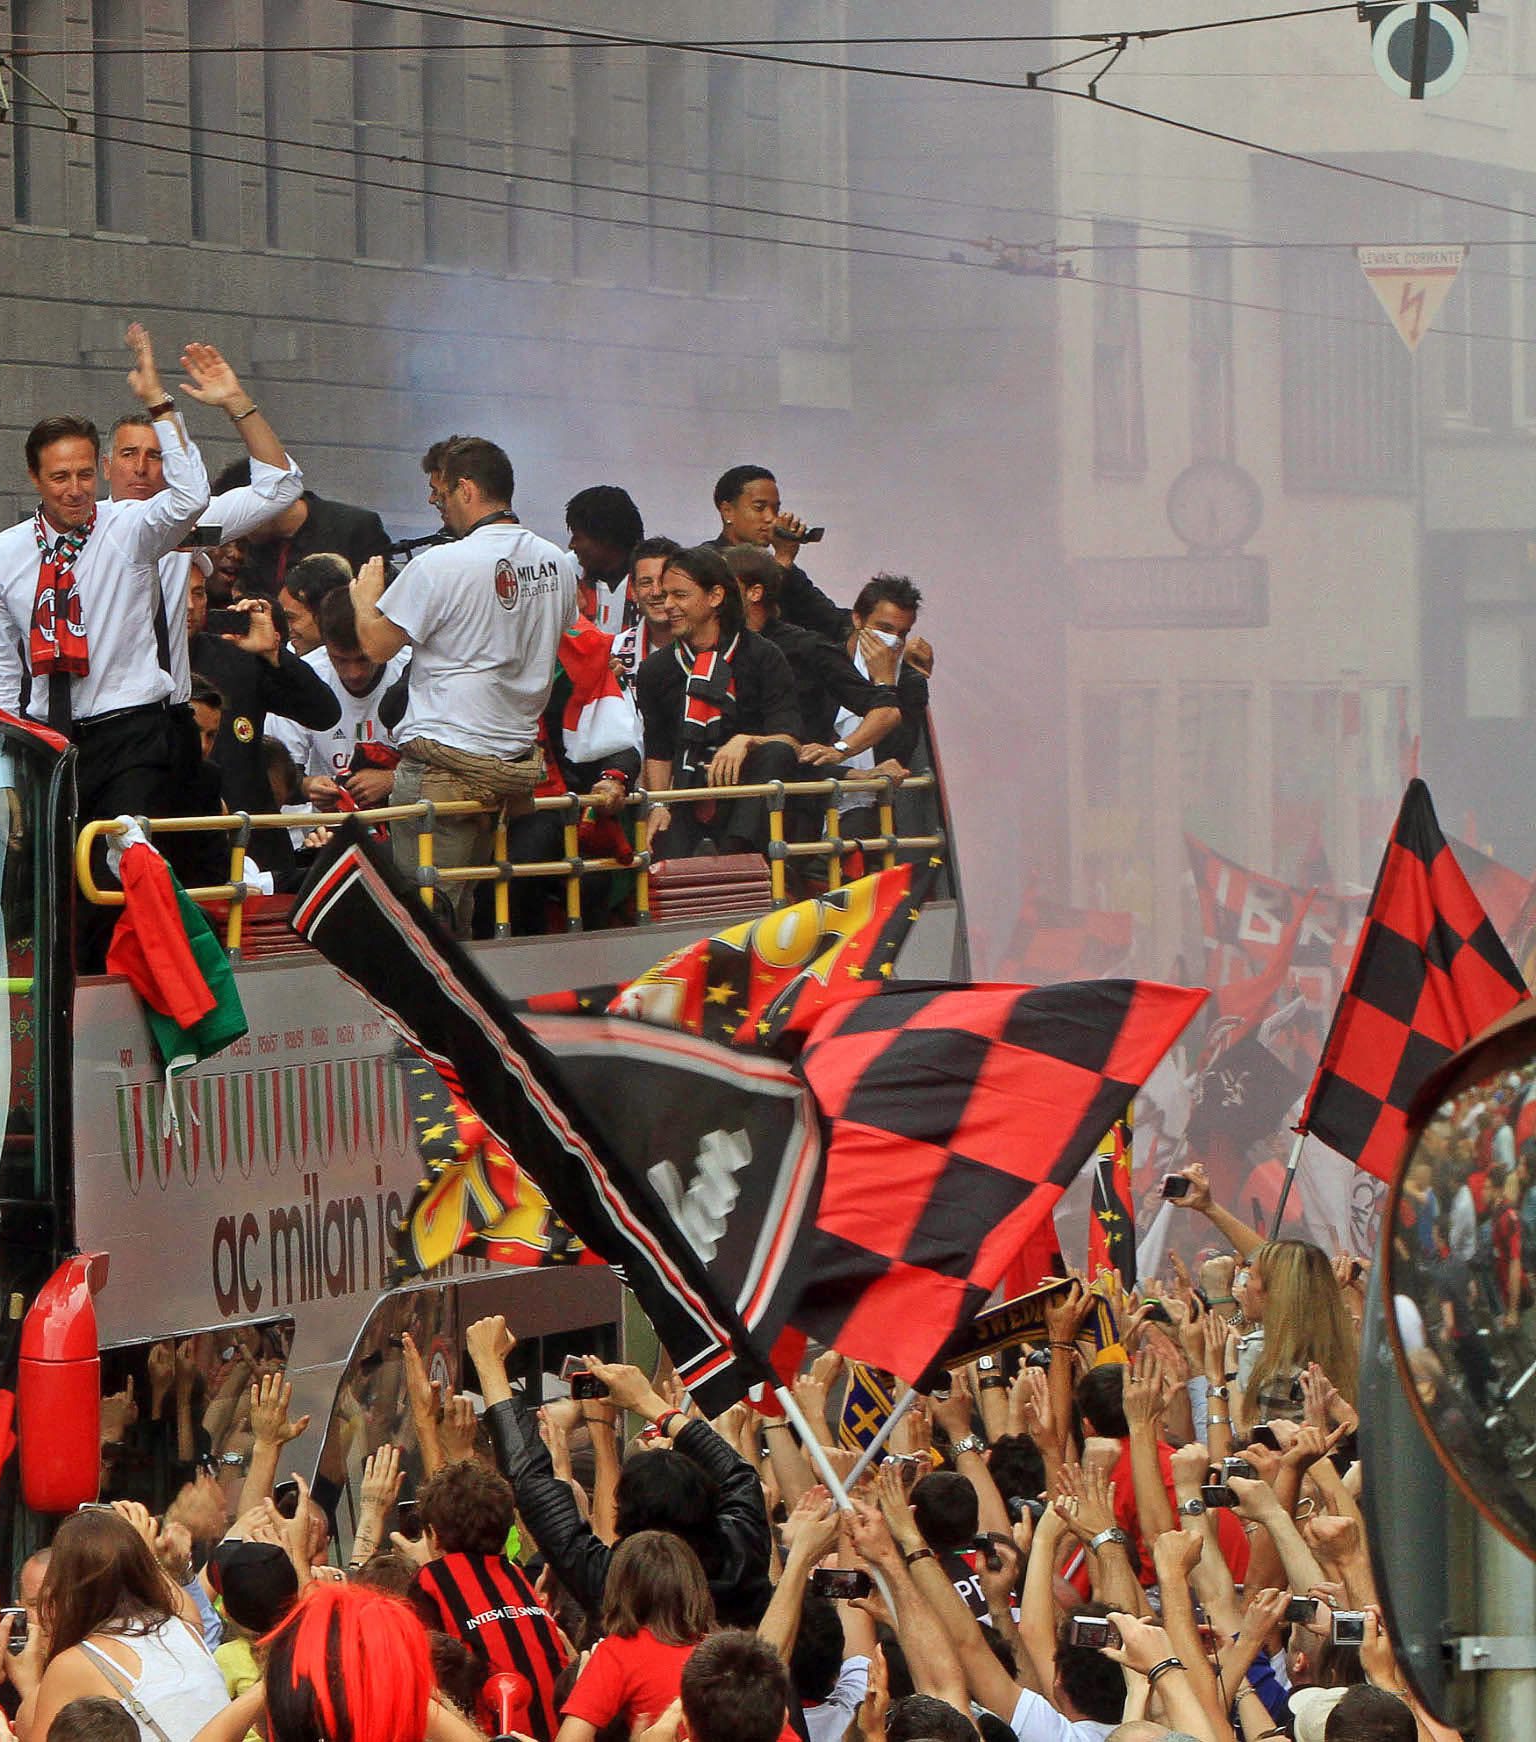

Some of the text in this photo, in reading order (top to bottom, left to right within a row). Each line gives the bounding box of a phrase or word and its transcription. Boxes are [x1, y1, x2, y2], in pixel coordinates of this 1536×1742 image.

[517, 560, 559, 581] MILAN
[213, 1211, 263, 1318] ac
[268, 1171, 370, 1308] milan
[466, 1609, 506, 1630] INTESA
